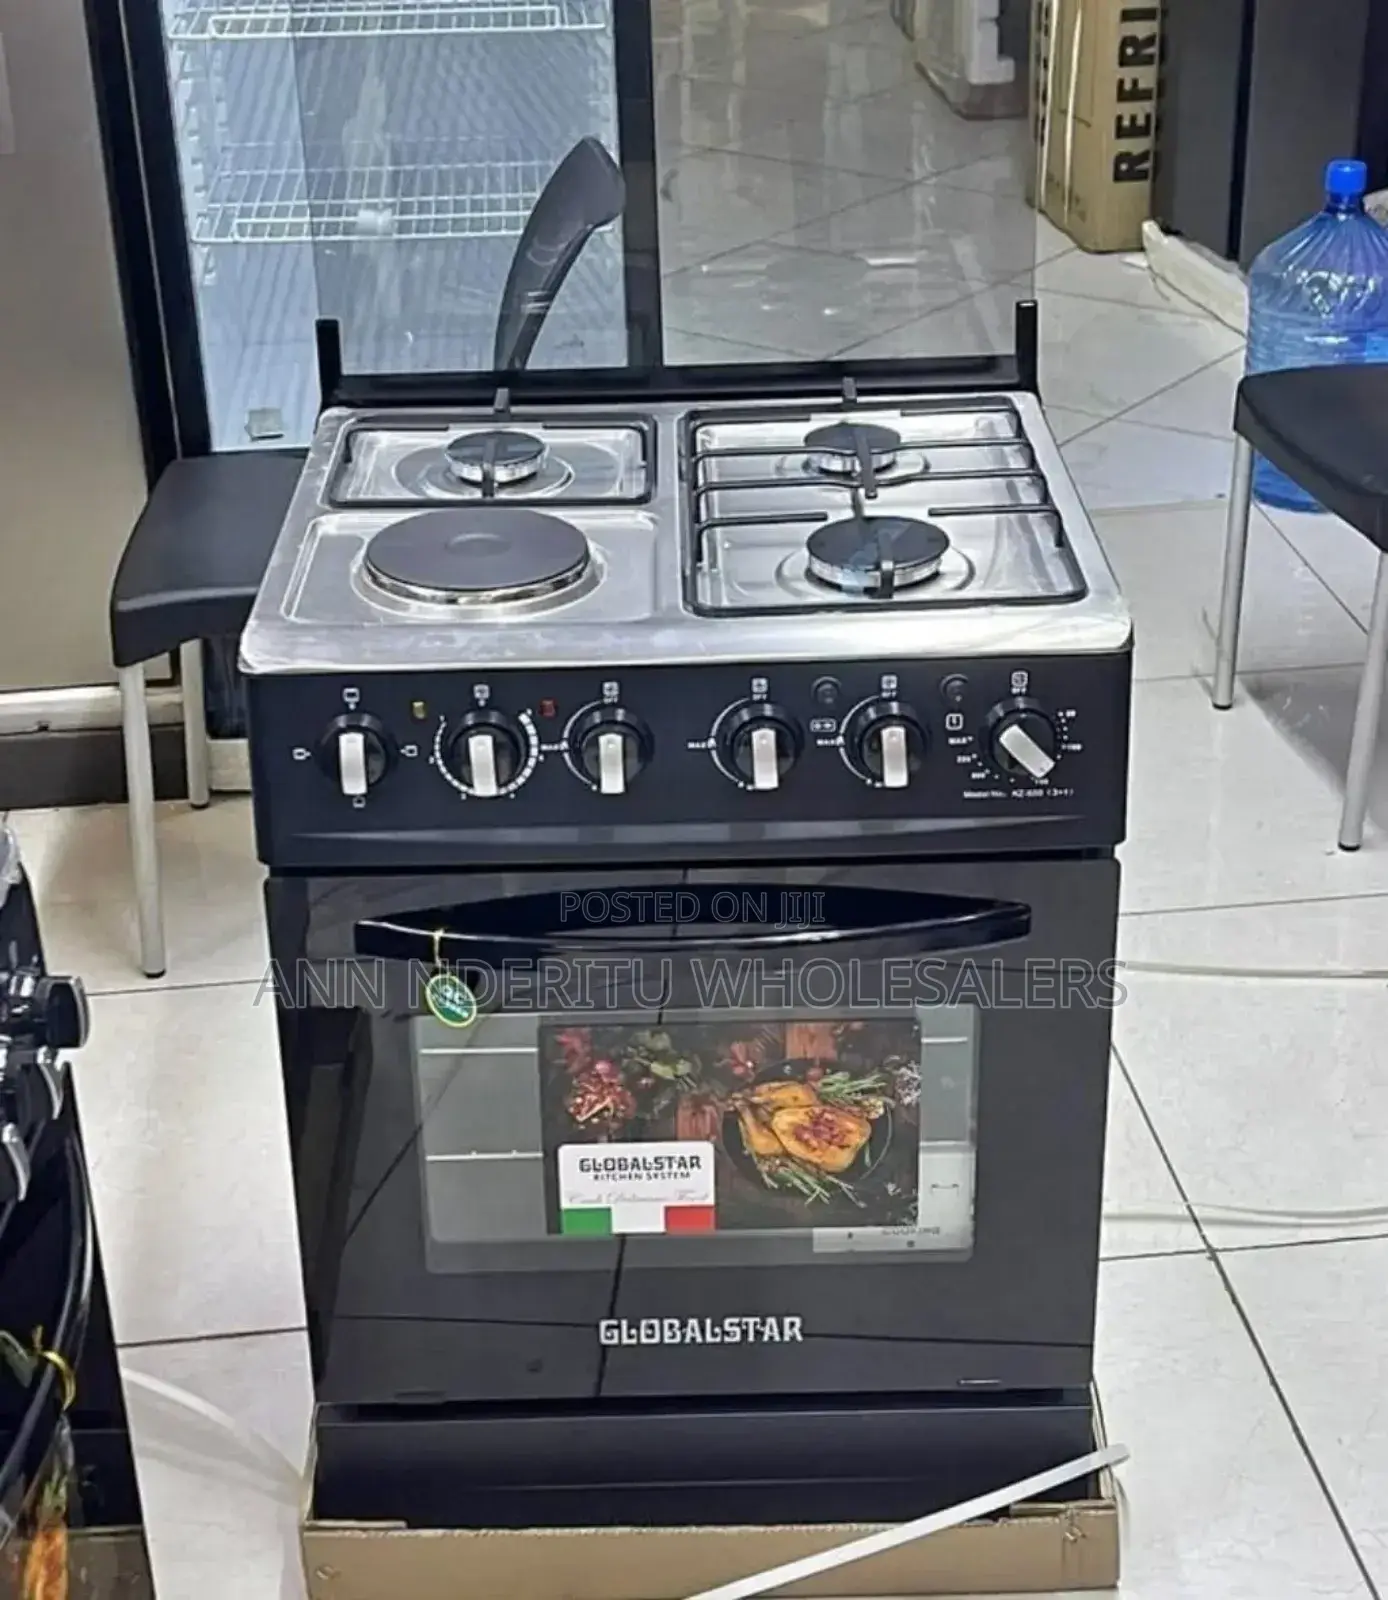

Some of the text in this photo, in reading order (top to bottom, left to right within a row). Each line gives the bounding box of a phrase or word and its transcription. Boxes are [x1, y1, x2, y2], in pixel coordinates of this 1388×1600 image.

[1112, 7, 1158, 183] REFRI
[578, 1155, 703, 1174] GLOBALSTAR
[593, 1170, 691, 1182] KITCHEN SYSTEM
[599, 1315, 804, 1346] GLOBALSTAR
